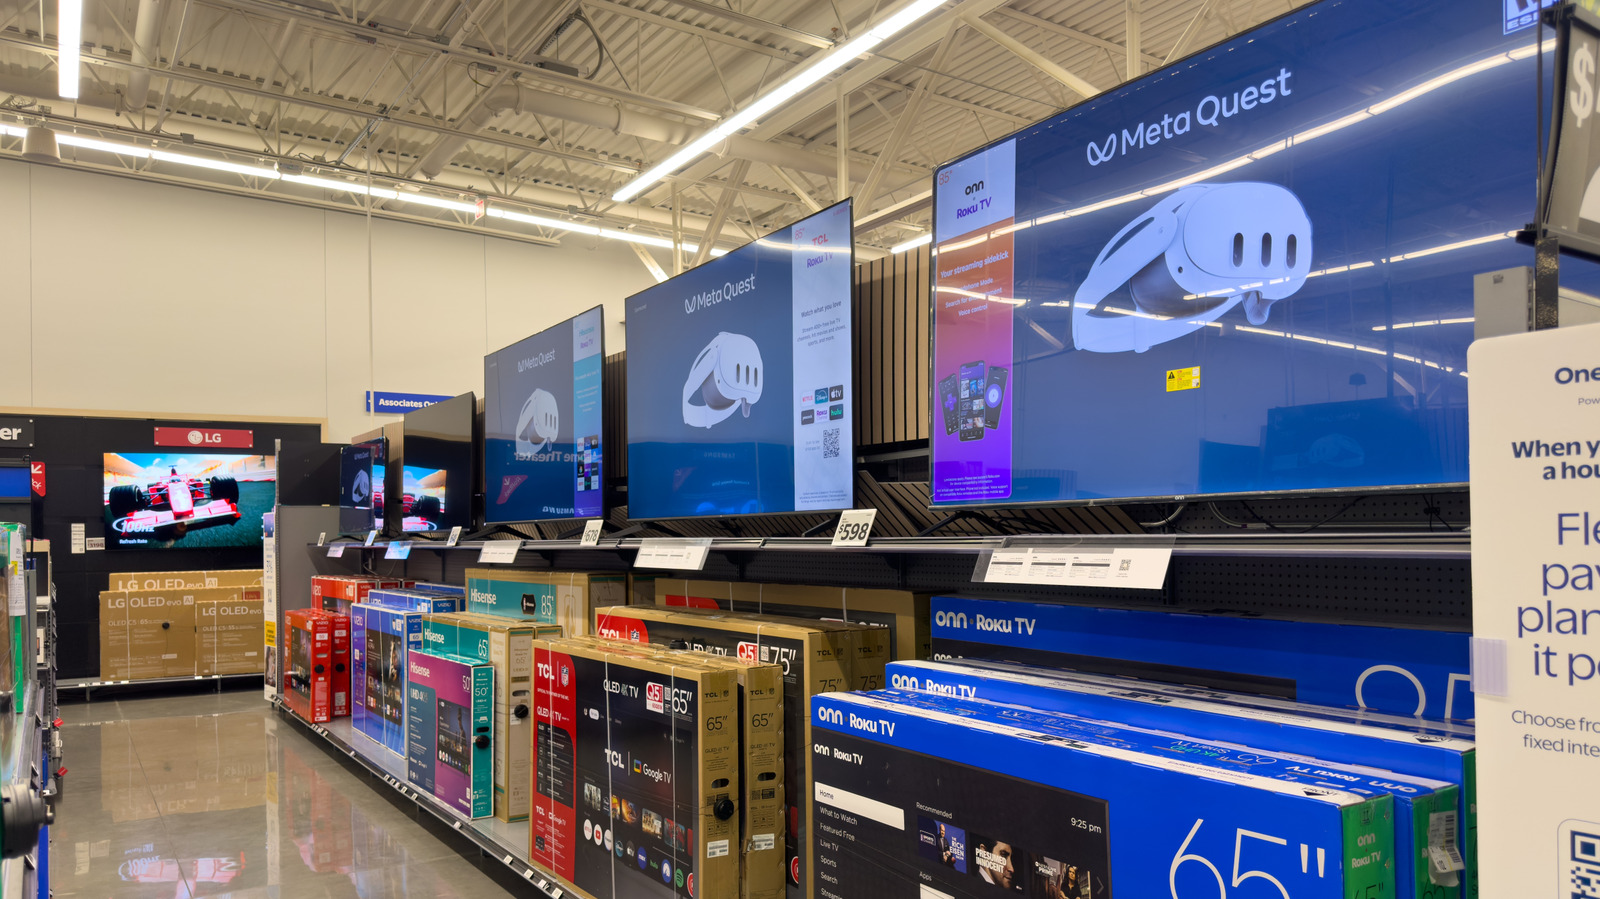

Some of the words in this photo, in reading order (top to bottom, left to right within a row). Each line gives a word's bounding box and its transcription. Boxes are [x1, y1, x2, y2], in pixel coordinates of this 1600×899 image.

[1121, 111, 1190, 155] Meta
[1196, 68, 1292, 127] Quest
[965, 180, 984, 196] onn
[956, 204, 978, 219] Roku
[980, 196, 992, 210] TV
[812, 234, 828, 246] TCL
[806, 256, 824, 268] Roku
[941, 270, 953, 278] Your
[954, 260, 983, 275] streaming
[984, 250, 1008, 265] sidekick
[697, 290, 722, 310] Meta
[723, 273, 756, 300] Quest
[801, 309, 813, 318] Watch
[814, 305, 824, 314] what
[824, 304, 832, 312] you
[833, 300, 841, 309] love
[525, 356, 538, 370] Meta
[538, 348, 556, 366] Quest
[379, 398, 422, 408] Associates
[0, 427, 22, 440] er
[205, 433, 222, 443] LG
[1511, 440, 1581, 458] When
[1543, 465, 1556, 480] a
[839, 523, 869, 540] $598
[118, 580, 138, 590] LG
[144, 579, 184, 590] OLED
[1542, 564, 1600, 596] pa
[108, 598, 125, 608] LG
[130, 597, 165, 608] OLED
[470, 588, 496, 605] Hisense
[541, 594, 554, 616] 85"
[202, 607, 216, 616] LG
[220, 606, 248, 615] OLED
[936, 610, 967, 628] onn
[976, 614, 1012, 633] Roku
[1014, 618, 1036, 636] TV
[424, 628, 444, 644] Hisense
[770, 646, 796, 675] 75"
[1533, 643, 1558, 677] it
[1568, 653, 1600, 686] p
[410, 661, 430, 678] Hisense
[537, 662, 555, 680] TCL
[820, 678, 842, 692] 75"
[860, 675, 882, 690] 75"
[891, 674, 919, 690] onn
[926, 679, 956, 696] Roku
[958, 684, 977, 699] TV
[475, 687, 488, 696] 50"
[603, 679, 620, 694] QLED
[629, 686, 639, 698] TV
[646, 682, 660, 701] Q5
[672, 688, 692, 714] 65"
[537, 706, 549, 717] QLED
[555, 711, 561, 721] TV
[752, 713, 773, 727] 65"
[818, 706, 843, 725] onn
[850, 713, 877, 733] Roku
[879, 720, 895, 737] TV
[1511, 710, 1576, 730] Choose
[707, 716, 727, 731] 65"
[1523, 734, 1564, 752] fixed
[1568, 740, 1600, 758] inte
[814, 744, 829, 756] onn
[834, 748, 852, 762] Roku
[853, 753, 863, 765] TV
[605, 748, 624, 769] TCL
[643, 764, 663, 782] Google
[663, 772, 671, 784] TV
[1313, 770, 1360, 781] Roku
[820, 790, 834, 800] Home
[1369, 781, 1417, 793] onn
[820, 806, 834, 816] What
[834, 811, 839, 819] to
[841, 814, 857, 825] Watch
[916, 802, 952, 819] Recommended
[820, 823, 842, 837] Featured
[843, 831, 855, 841] Free
[1070, 817, 1087, 830] 9:25
[1088, 823, 1102, 833] pm
[820, 840, 831, 849] Live
[831, 844, 839, 852] TV
[952, 840, 964, 850] RICH
[1357, 833, 1376, 847] onn
[820, 855, 837, 868] Sports
[976, 848, 1006, 866] PRESUMED
[976, 857, 1004, 873] INNOCENT
[1169, 818, 1325, 899] 65"
[1352, 854, 1370, 868] Roku
[1371, 851, 1381, 861] TV
[820, 872, 838, 885] Search
[920, 871, 932, 881] Apps
